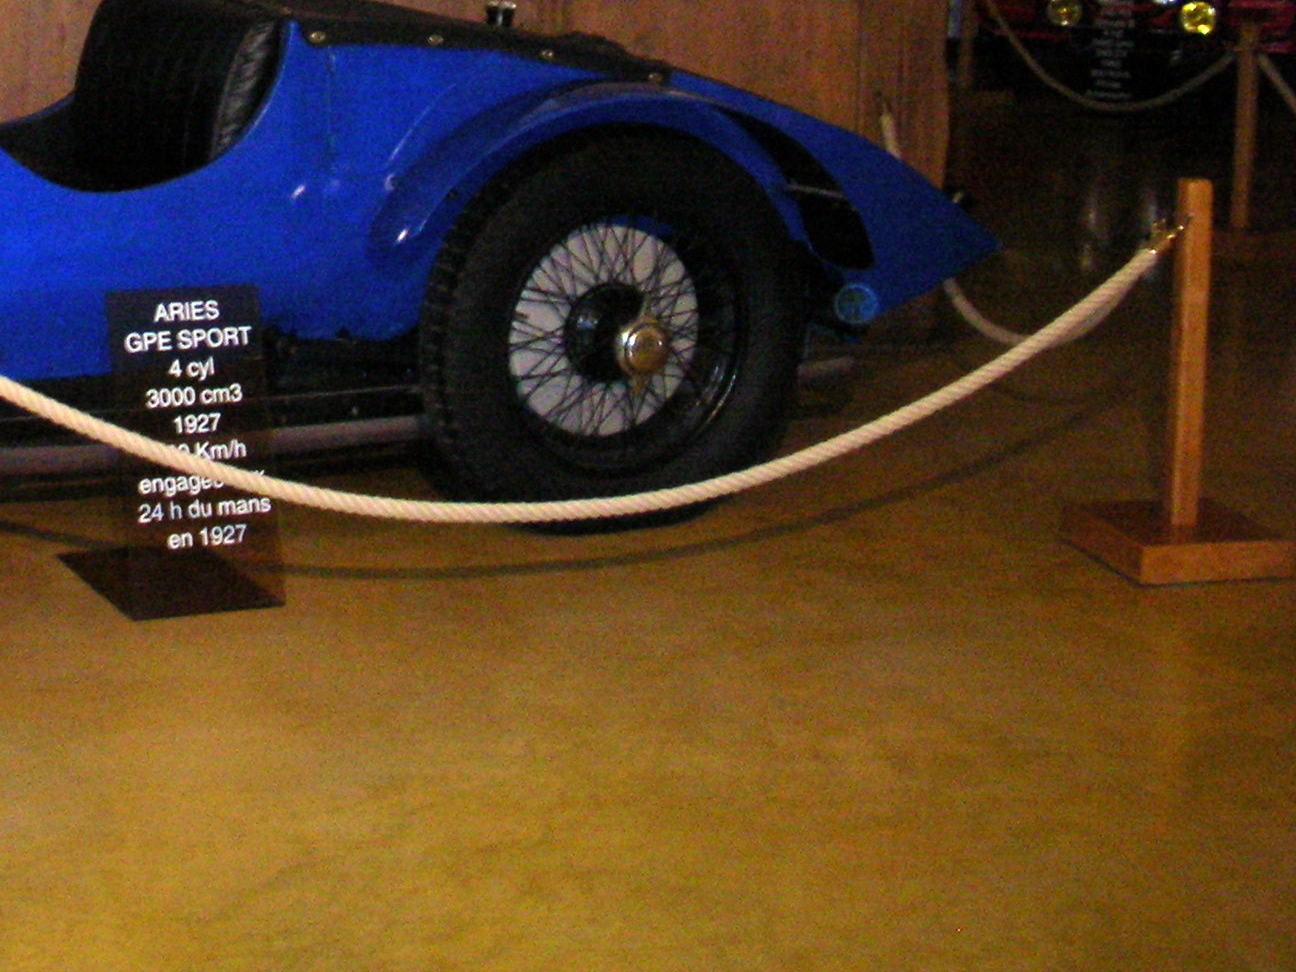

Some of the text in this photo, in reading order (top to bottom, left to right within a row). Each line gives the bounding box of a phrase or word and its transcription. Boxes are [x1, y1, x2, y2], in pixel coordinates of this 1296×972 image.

[153, 300, 220, 323] ARIES
[124, 325, 253, 354] GPE SPORT
[168, 356, 216, 381] 4 cyl
[145, 383, 243, 409] 3000 cm3
[173, 412, 221, 435] 1927
[195, 439, 247, 460] Km/h
[137, 496, 271, 524] 24 h du mans
[167, 524, 247, 550] en 1927
